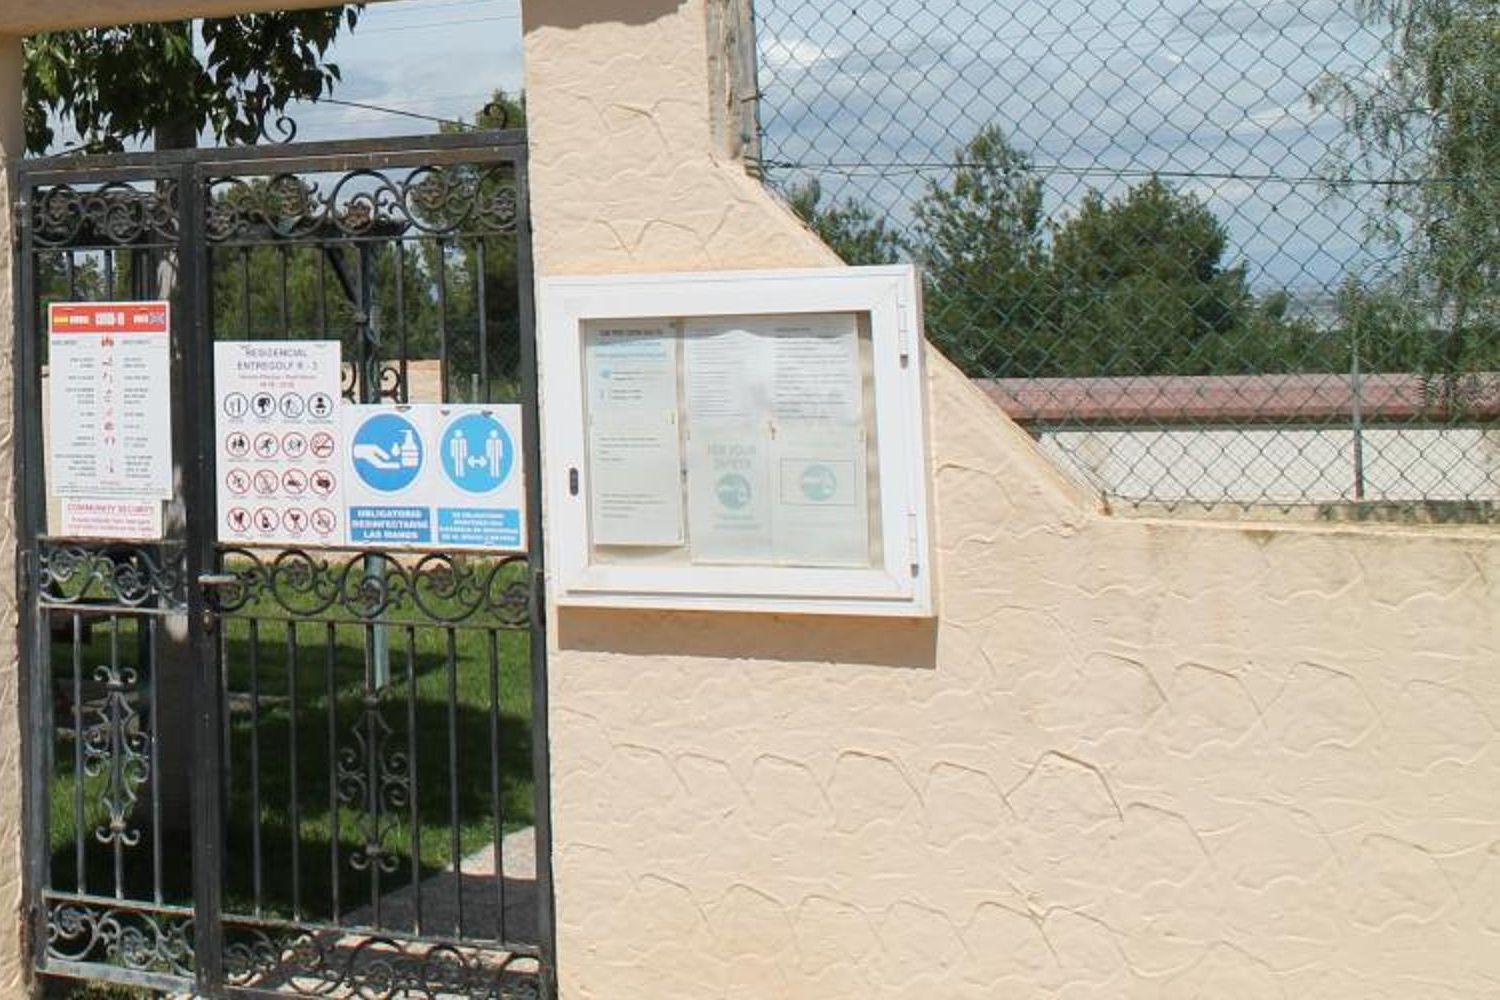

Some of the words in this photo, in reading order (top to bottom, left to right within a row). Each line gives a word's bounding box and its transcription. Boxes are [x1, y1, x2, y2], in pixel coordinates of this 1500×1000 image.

[244, 348, 308, 357] RESIDENCIAL
[237, 361, 294, 371] ENTREGOLF
[67, 503, 116, 513] COMMUNITY
[357, 509, 422, 519] OBLIGATORIO
[363, 530, 384, 539] LAS
[384, 530, 419, 539] MANOS
